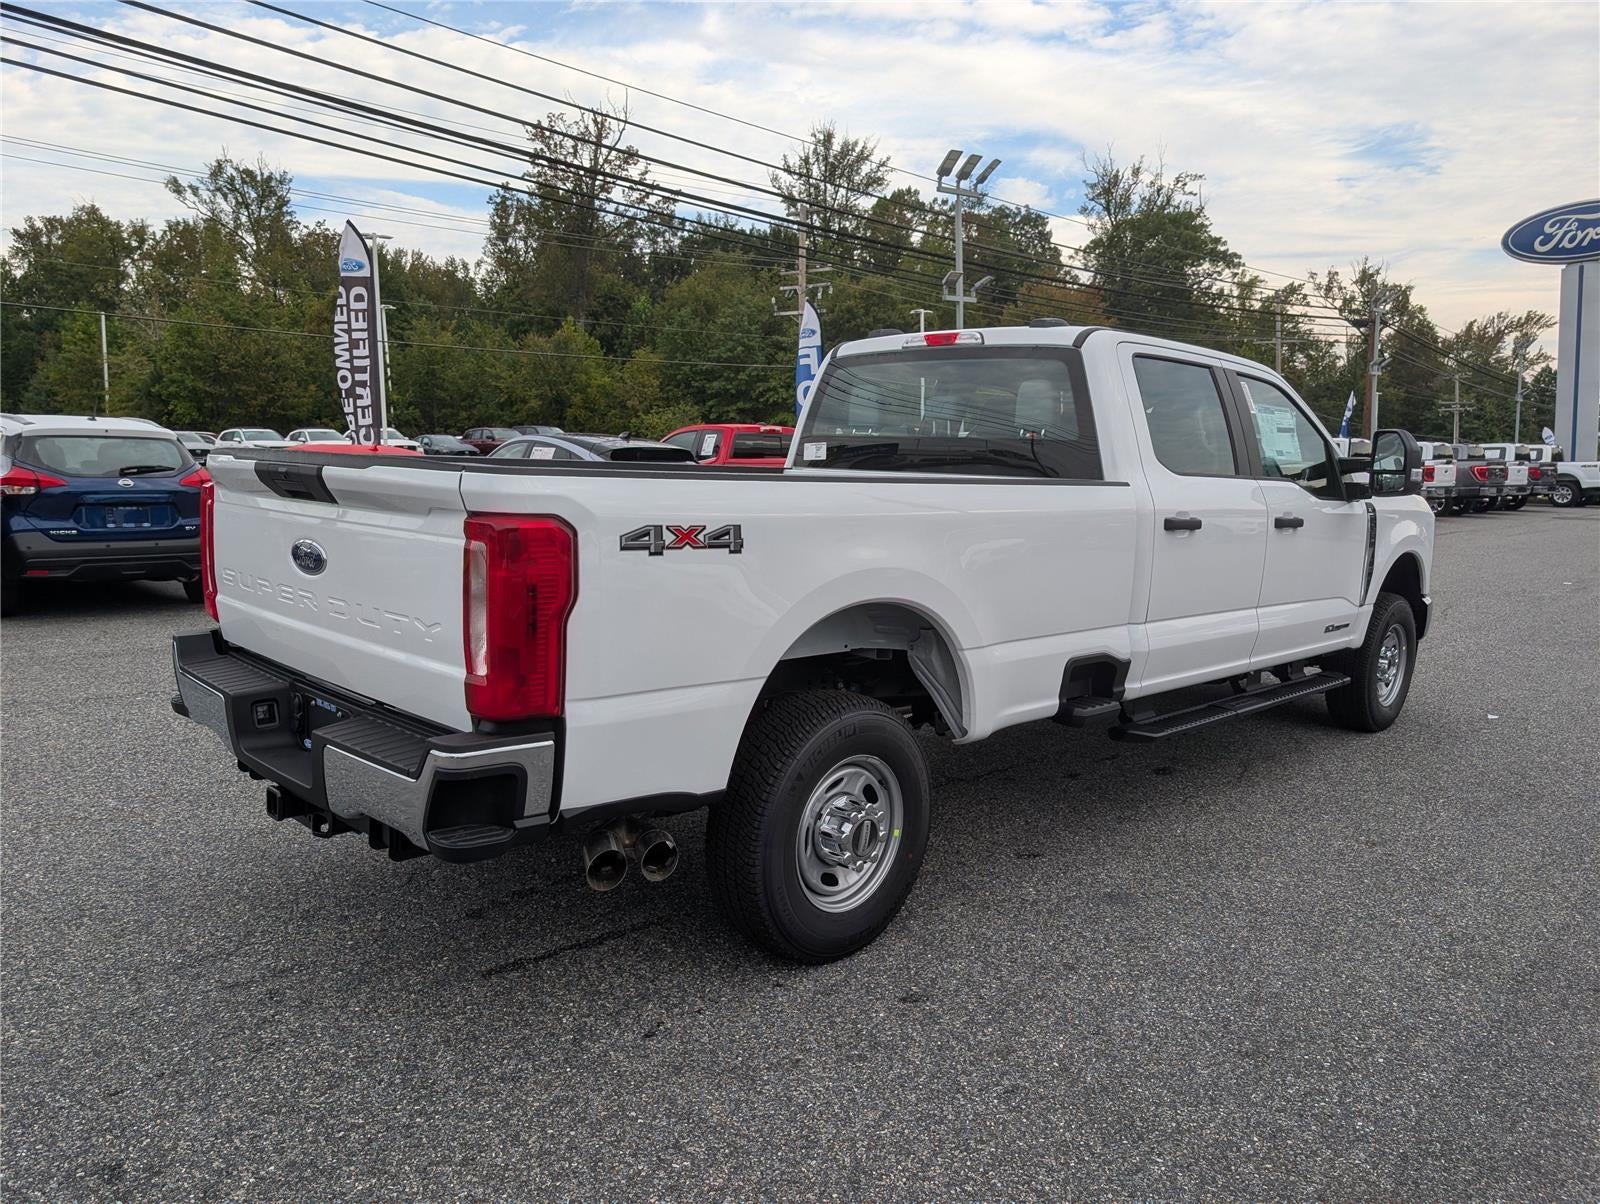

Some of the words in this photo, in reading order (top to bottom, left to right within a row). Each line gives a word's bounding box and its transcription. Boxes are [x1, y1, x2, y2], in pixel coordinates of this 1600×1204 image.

[1534, 212, 1600, 252] For
[222, 568, 318, 612] SUPER
[328, 596, 441, 642] DUTY
